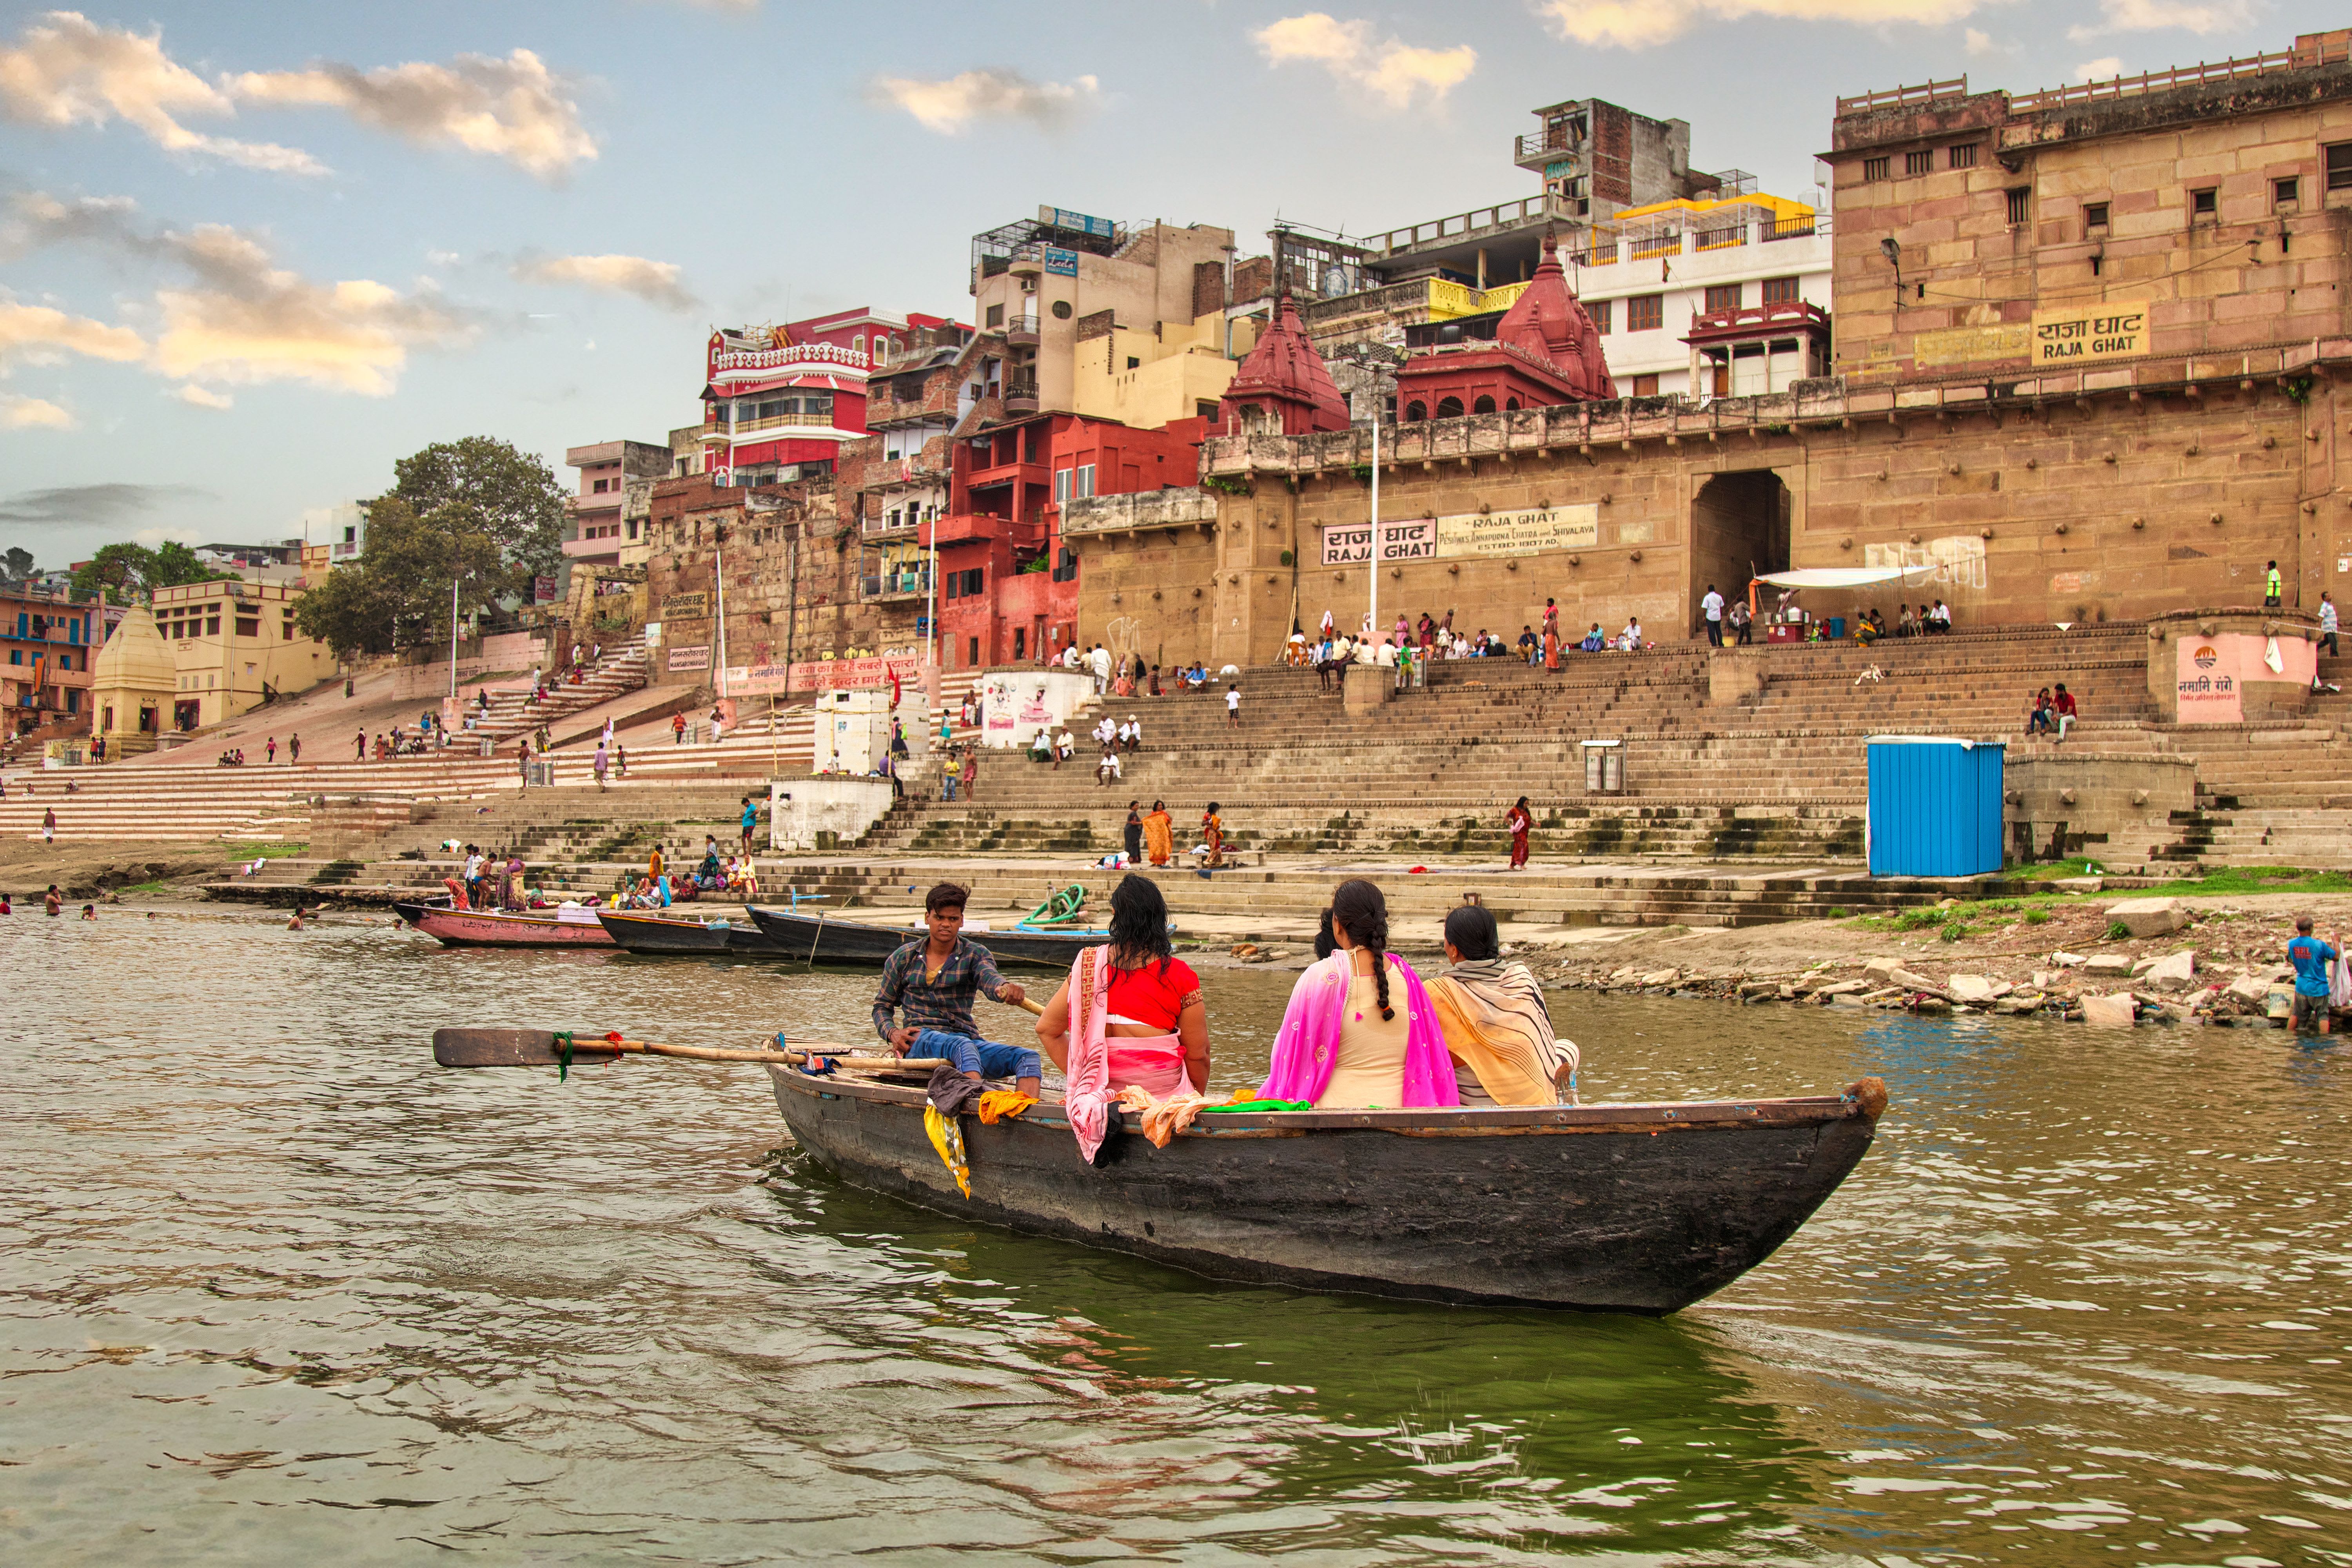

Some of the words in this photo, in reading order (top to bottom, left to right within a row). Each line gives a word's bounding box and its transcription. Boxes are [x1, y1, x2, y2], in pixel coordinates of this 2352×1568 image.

[1048, 255, 1074, 269] Leela
[2038, 320, 2089, 340] राजा
[2093, 314, 2143, 334] घाट
[2043, 342, 2083, 359] RAJA
[2092, 336, 2136, 353] GHAT
[1473, 516, 1511, 528] RAJA
[1518, 512, 1559, 525] GHAT
[1385, 525, 1428, 542] घाट
[1472, 531, 1510, 543] ANNAPURNA
[1553, 524, 1595, 536] SHIVALAYA
[1384, 542, 1434, 558] GHAT
[848, 660, 855, 672] है
[857, 659, 883, 670] सबसे
[2179, 675, 2211, 693] नमामि
[2214, 675, 2233, 692] गंगे
